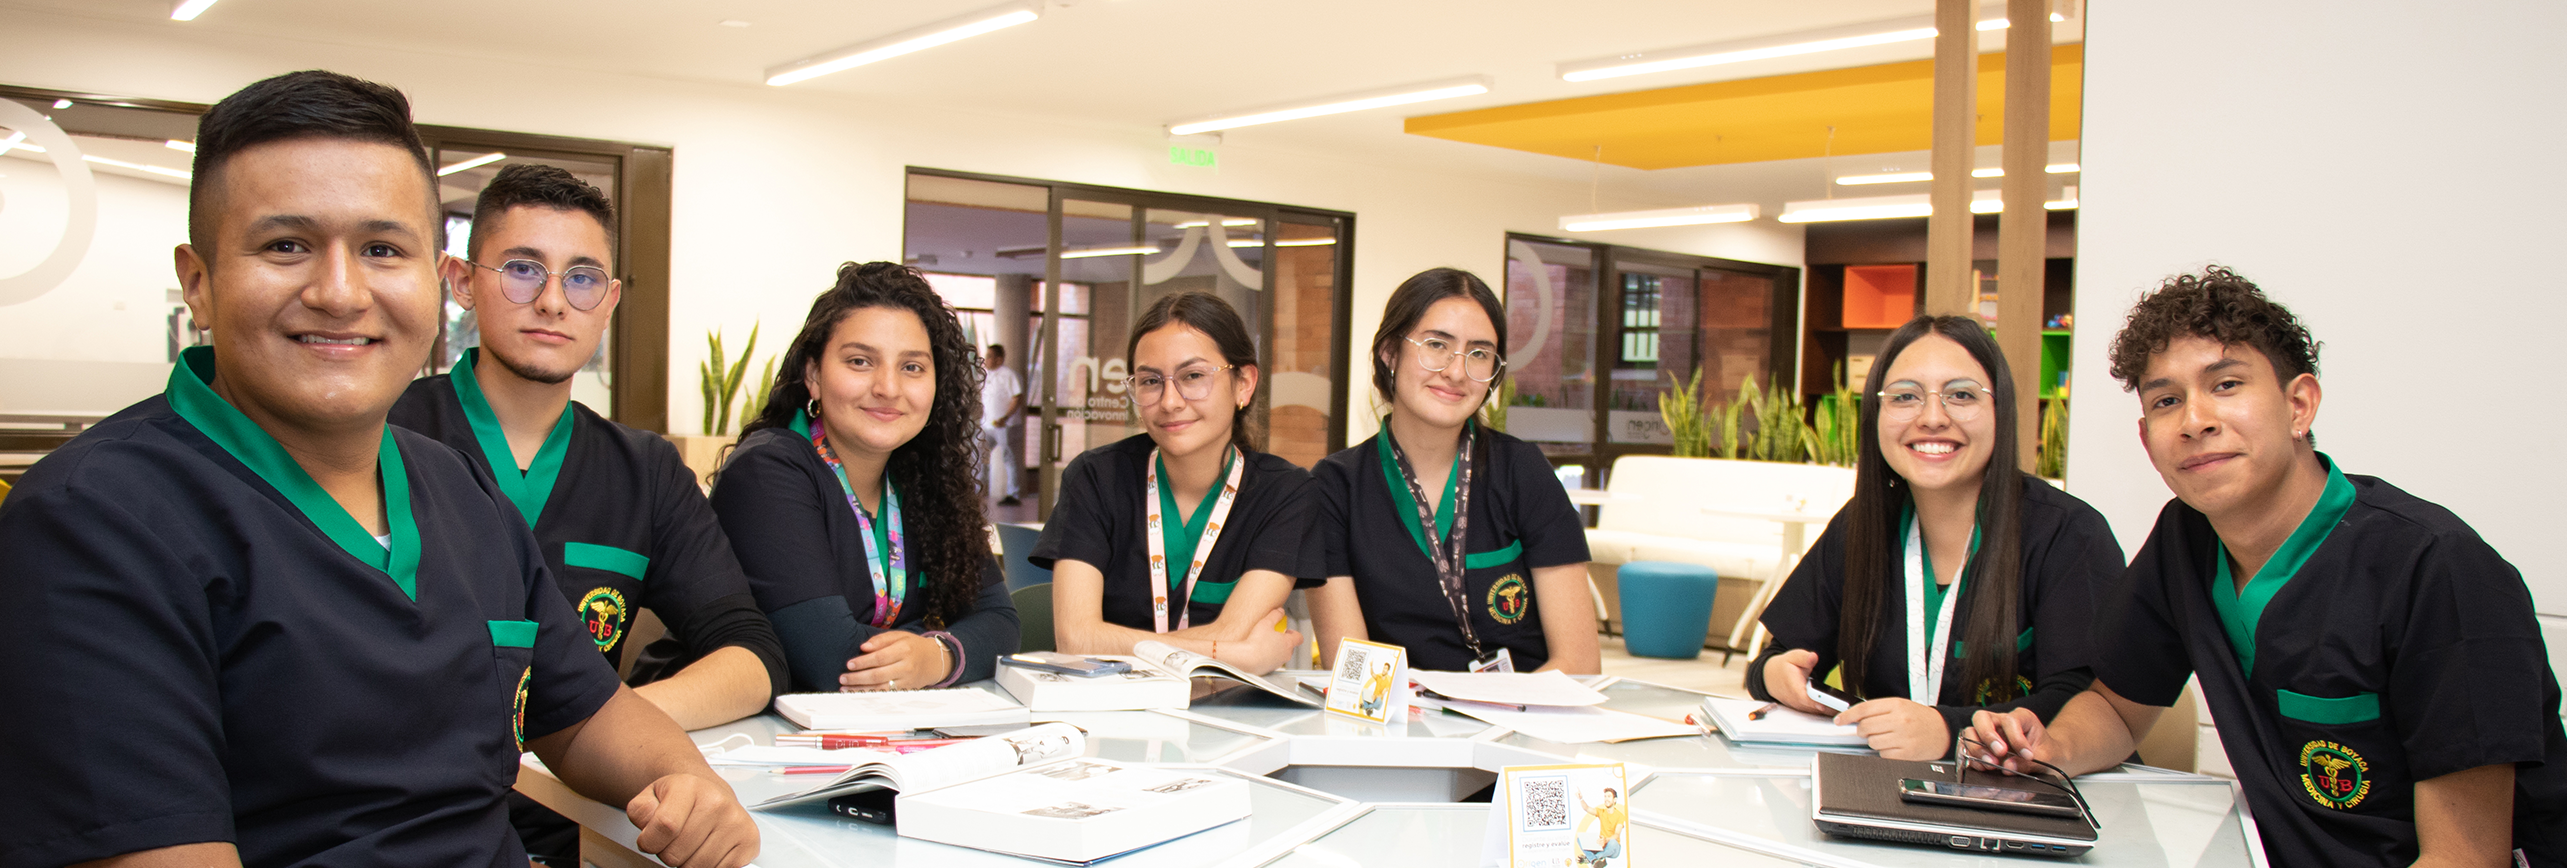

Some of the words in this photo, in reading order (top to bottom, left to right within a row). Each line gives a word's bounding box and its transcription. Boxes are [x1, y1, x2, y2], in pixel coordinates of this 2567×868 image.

[1169, 146, 1216, 168] SALIDA
[589, 620, 599, 633] U
[603, 624, 612, 637] B
[2327, 741, 2339, 751] DE
[2340, 746, 2369, 773] BOYACA
[2300, 773, 2334, 809] MEDICINA
[2344, 780, 2371, 809] CIRUGIA
[2318, 775, 2330, 789] U
[2338, 779, 2353, 792] B
